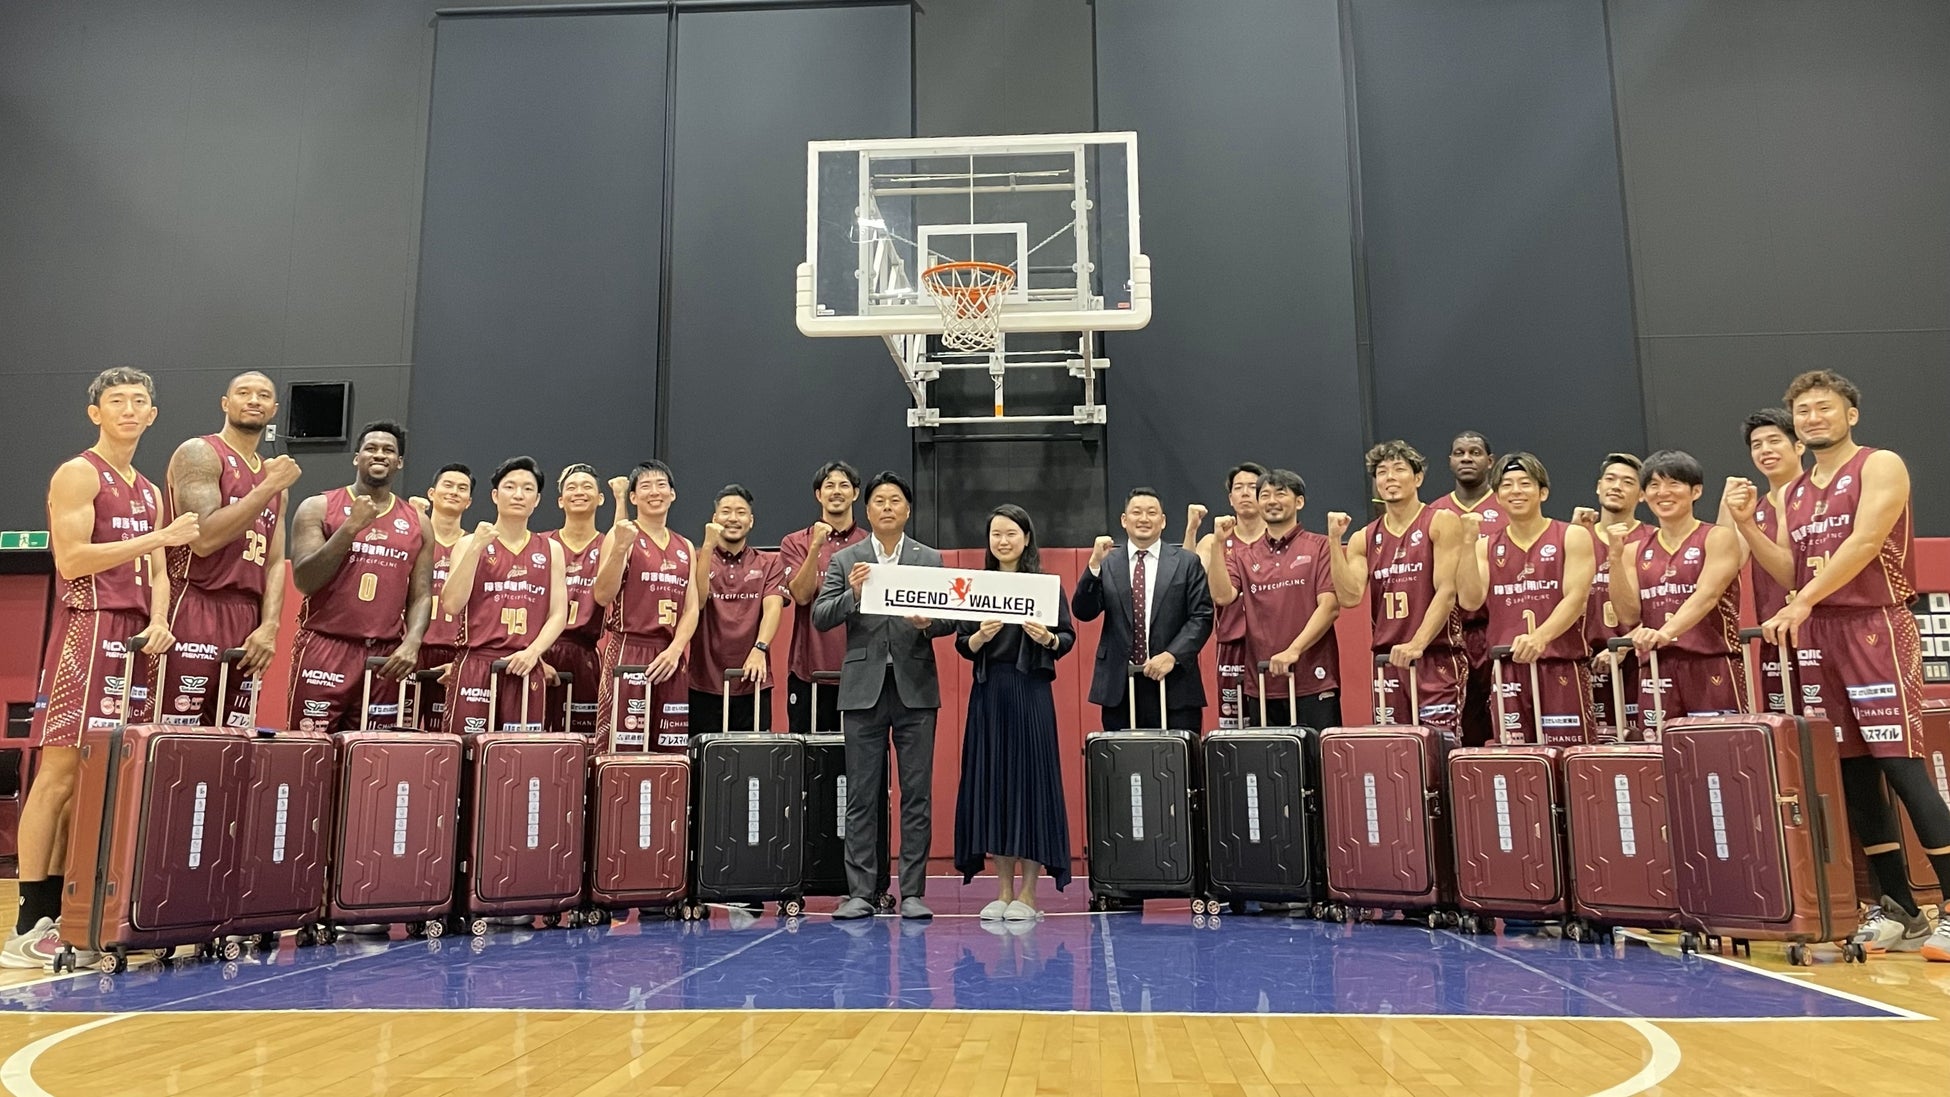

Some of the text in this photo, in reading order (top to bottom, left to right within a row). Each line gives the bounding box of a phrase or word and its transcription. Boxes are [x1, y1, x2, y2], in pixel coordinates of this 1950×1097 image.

[242, 530, 268, 567] 32
[358, 572, 378, 602] 0
[884, 589, 1035, 613] LEGEND WALKER
[1383, 591, 1409, 620] 13
[500, 607, 528, 635] 49
[301, 668, 345, 683] MONIC
[306, 678, 337, 688] RENTAL
[1860, 707, 1901, 718] CHANGE
[1548, 735, 1583, 743] CHANGE
